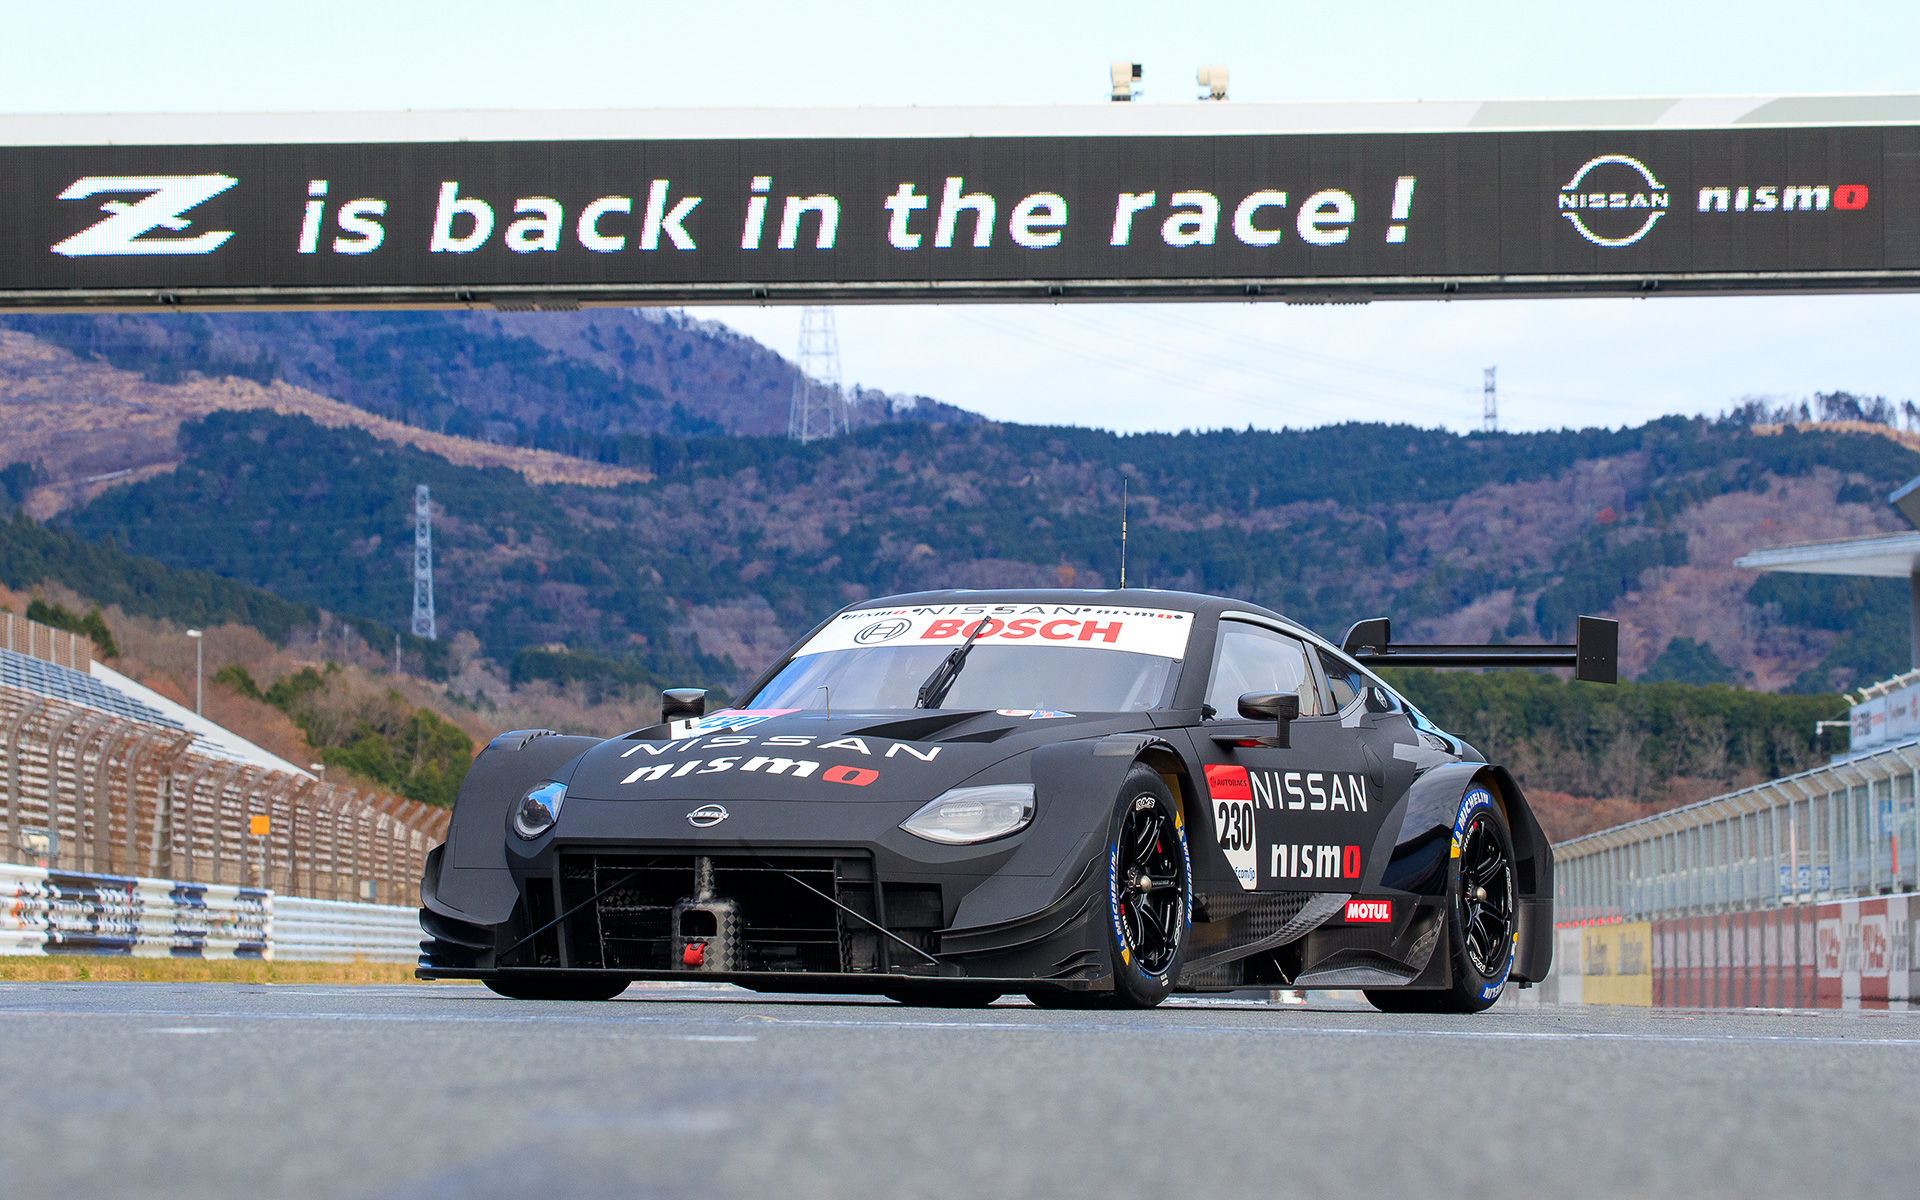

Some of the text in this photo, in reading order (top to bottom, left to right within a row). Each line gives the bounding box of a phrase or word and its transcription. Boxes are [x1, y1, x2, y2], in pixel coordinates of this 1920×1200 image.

[1558, 193, 1669, 209] NISSAN
[1698, 184, 1869, 213] nismo
[297, 180, 386, 255] is
[430, 180, 702, 255] back
[741, 176, 839, 250] in
[884, 177, 1067, 250] the
[1110, 188, 1356, 248] race
[1385, 175, 1416, 243] !
[918, 605, 1080, 617] NISSAN
[919, 618, 1123, 643] BOSCH
[620, 735, 943, 762] NISSAN
[620, 755, 880, 787] nismo
[1216, 779, 1248, 787] AUTOBACS
[1250, 771, 1368, 813] NISSAN
[1457, 791, 1490, 831] MICHELIN
[1218, 801, 1254, 852] 230
[1271, 844, 1361, 879] nismo
[1110, 851, 1123, 937] MICHELIN
[1347, 903, 1389, 920] MOTUL
